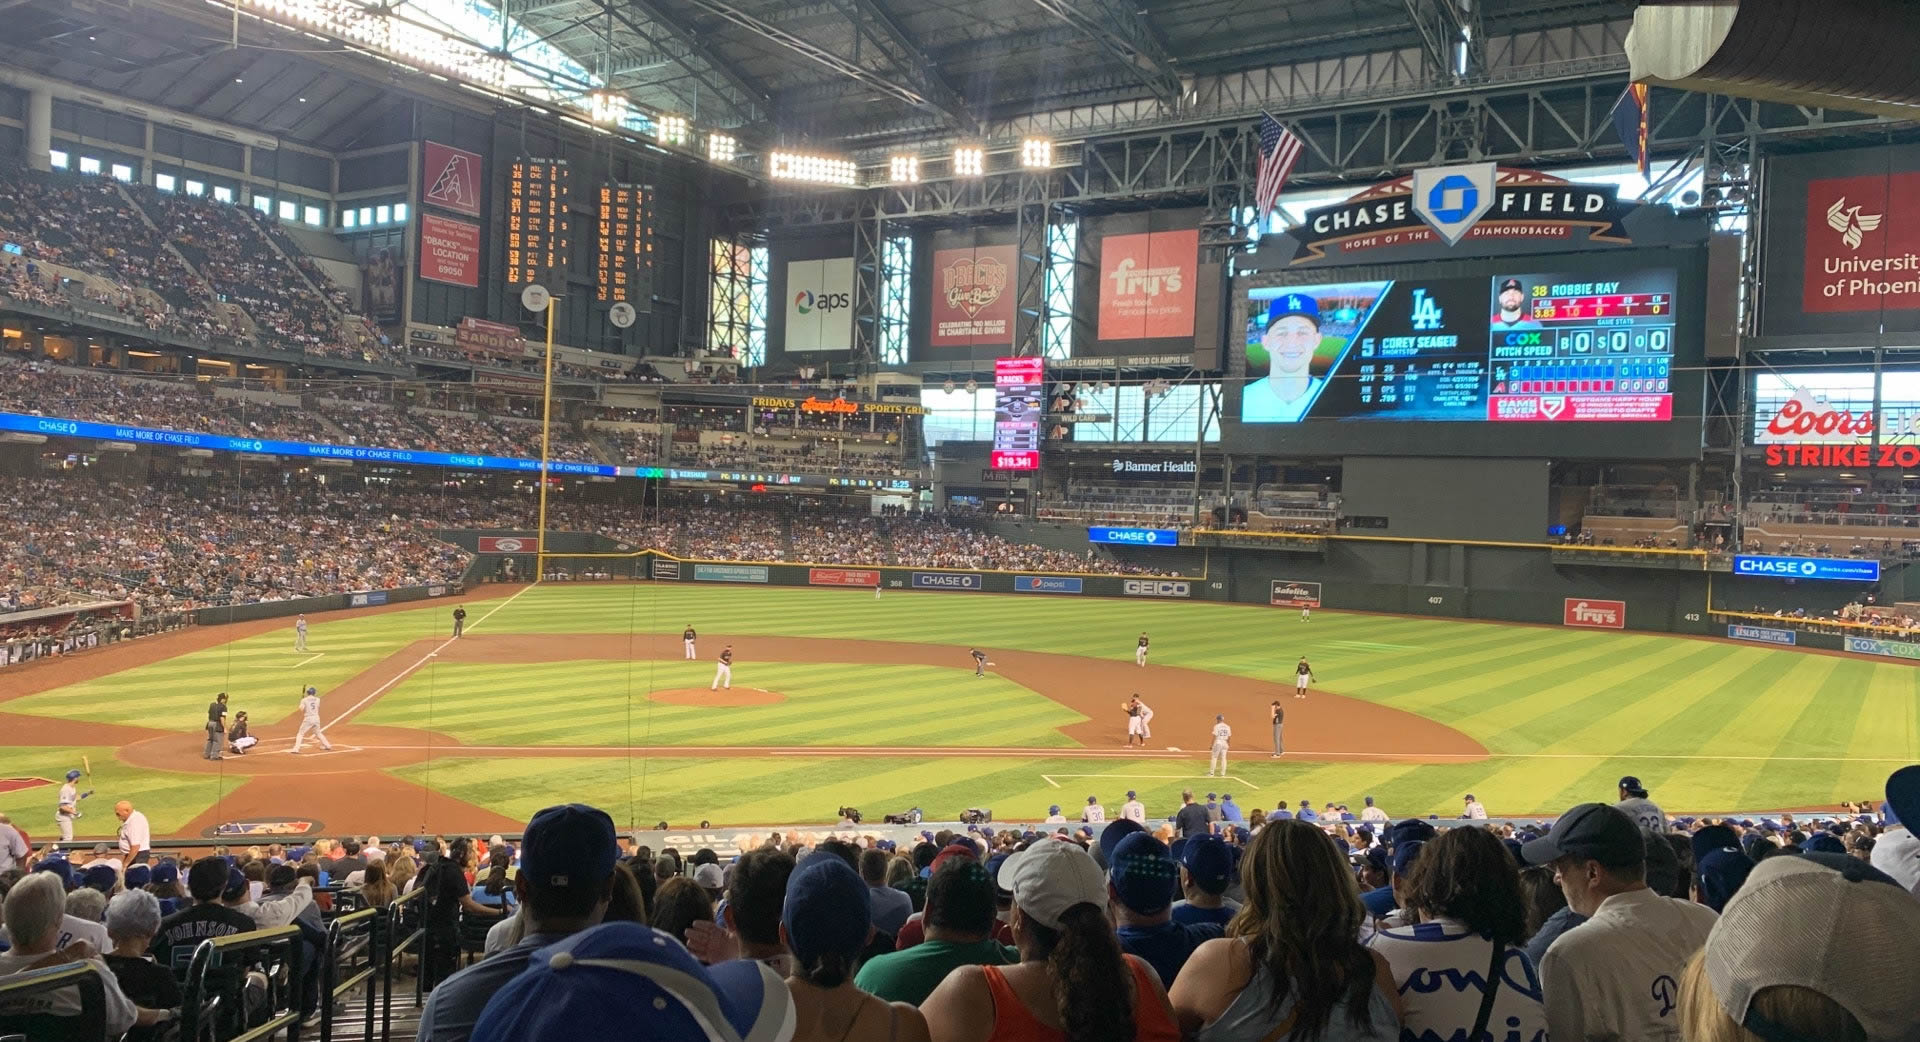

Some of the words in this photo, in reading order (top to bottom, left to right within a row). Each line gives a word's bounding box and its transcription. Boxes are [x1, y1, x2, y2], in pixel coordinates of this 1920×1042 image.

[1314, 201, 1407, 233] CHASE
[1502, 193, 1604, 213] FIELD
[1345, 237, 1377, 248] HOME
[1385, 234, 1399, 244] OF
[1408, 231, 1430, 241] THE
[1473, 226, 1565, 236] DIAMONDBACKS
[432, 247, 469, 261] LOCATION
[1824, 253, 1920, 274] Universit
[438, 265, 462, 276] 69050
[1109, 258, 1182, 296] fry's
[1532, 286, 1548, 297] 38
[1551, 283, 1593, 296] ROBBIE
[1595, 282, 1619, 294] RAY
[1823, 279, 1846, 297] of
[817, 292, 849, 312] aps
[1411, 288, 1442, 330] LA
[1534, 309, 1556, 318] 3.83
[1565, 308, 1580, 317] 1.0
[1595, 307, 1603, 316] 0
[1653, 305, 1660, 314] 0
[939, 320, 971, 329] CELEBRATING
[938, 328, 945, 337] IN
[946, 327, 983, 336] CHARITABLE
[984, 326, 1005, 335] GIVING
[1505, 332, 1541, 345] COX
[1561, 338, 1569, 350] B
[1575, 333, 1590, 352] 0
[1597, 336, 1606, 349] S
[1612, 331, 1627, 351] 0
[1650, 331, 1666, 350] 0
[1361, 338, 1375, 357] 5
[1382, 336, 1416, 349] COREY
[1417, 335, 1458, 348] SEAGER
[1382, 348, 1419, 356] SHORTSTOP
[1496, 347, 1522, 356] PITCH
[1524, 345, 1553, 356] SPEED
[1078, 358, 1115, 366] CHAMPIONS
[1128, 357, 1149, 365] WORLD
[1150, 356, 1189, 364] CHAMPIONS
[1512, 369, 1519, 377] 0
[1622, 367, 1629, 375] 0
[1659, 366, 1666, 375] 0
[1512, 383, 1518, 391] 0
[1621, 382, 1628, 390] 0
[1633, 381, 1640, 389] 0
[1646, 381, 1653, 389] 0
[1658, 381, 1665, 389] 0
[752, 397, 795, 408] FRIDAY'S
[864, 404, 901, 413] SPORTS
[1767, 399, 1876, 435] Coors
[39, 421, 68, 433] CHASE
[116, 428, 134, 439] MAKE
[135, 429, 153, 440] MORE
[155, 432, 163, 441] OF
[164, 433, 183, 444] CHASE
[184, 435, 200, 445] FIELD
[229, 441, 251, 449] CHASE
[309, 446, 330, 455] MAKE
[332, 447, 354, 456] MORE
[356, 449, 367, 457] OF
[368, 450, 391, 459] CHASE
[392, 452, 412, 460] FIELD
[1766, 444, 1870, 467] STRIKE
[1877, 444, 1920, 467] ZO
[450, 456, 477, 465] CHASE
[519, 461, 535, 469] MAKE
[555, 463, 563, 471] OF
[564, 464, 582, 473] CHASE
[583, 465, 599, 473] FIELD
[997, 457, 1031, 467] $19,341
[1125, 460, 1162, 472] Banner
[1163, 460, 1197, 472] Health
[635, 467, 664, 478] COX
[680, 471, 707, 479] KERSHAW
[892, 480, 909, 488] 5:25
[1108, 531, 1144, 541] CHASE
[1740, 560, 1797, 573] CHASE
[921, 575, 960, 586] CHASE
[1043, 581, 1065, 589] pepsi
[1125, 580, 1189, 596] GEICO
[1274, 586, 1309, 596] Safelite
[1428, 596, 1443, 605] 407
[1572, 601, 1616, 624] fry's
[1684, 613, 1700, 622] 413
[1736, 627, 1759, 638] LESLIE'S
[1853, 640, 1877, 652] COX
[1891, 644, 1917, 655] COX
[1092, 811, 1103, 821] 30
[1134, 808, 1141, 818] 8
[165, 920, 238, 945] JOHNSON
